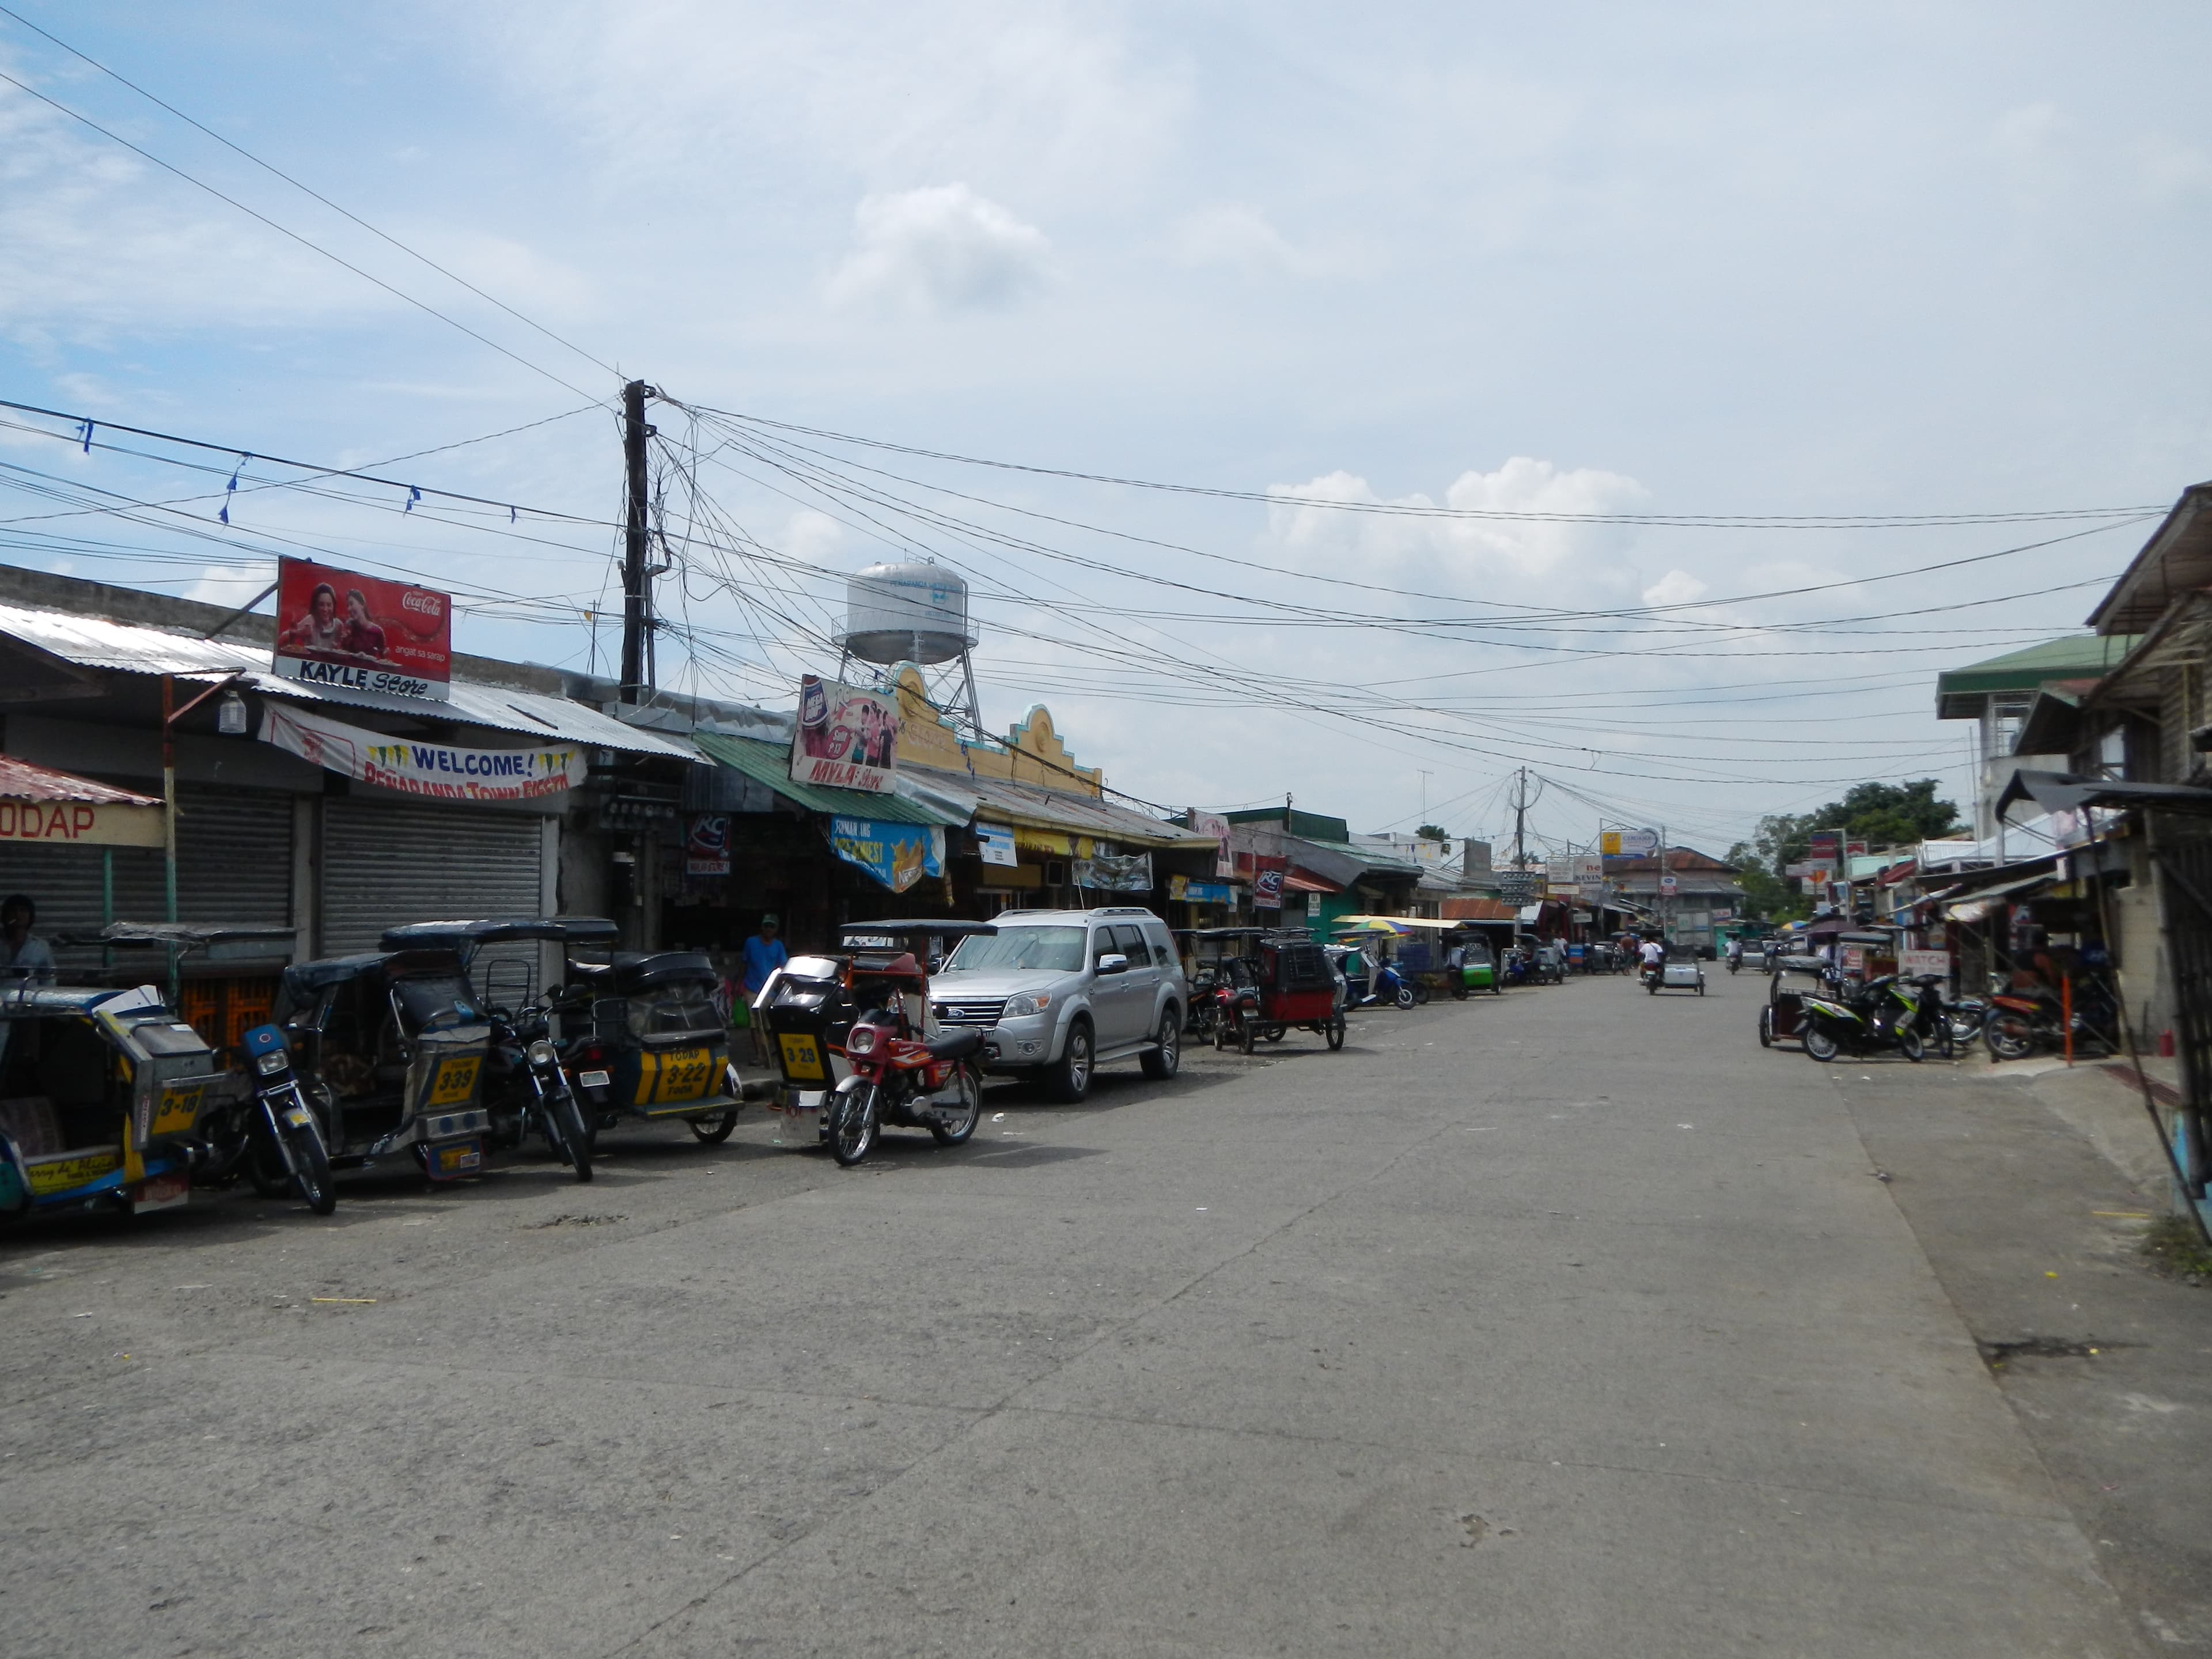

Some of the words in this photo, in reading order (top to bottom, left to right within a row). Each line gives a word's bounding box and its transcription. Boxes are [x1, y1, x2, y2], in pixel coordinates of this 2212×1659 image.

[395, 645, 416, 657] angat
[426, 652, 445, 662] sarap
[300, 661, 369, 687] KAYLE
[411, 745, 535, 778] WELCOME!
[1260, 870, 1281, 885] RC
[666, 1062, 705, 1085] 3-22
